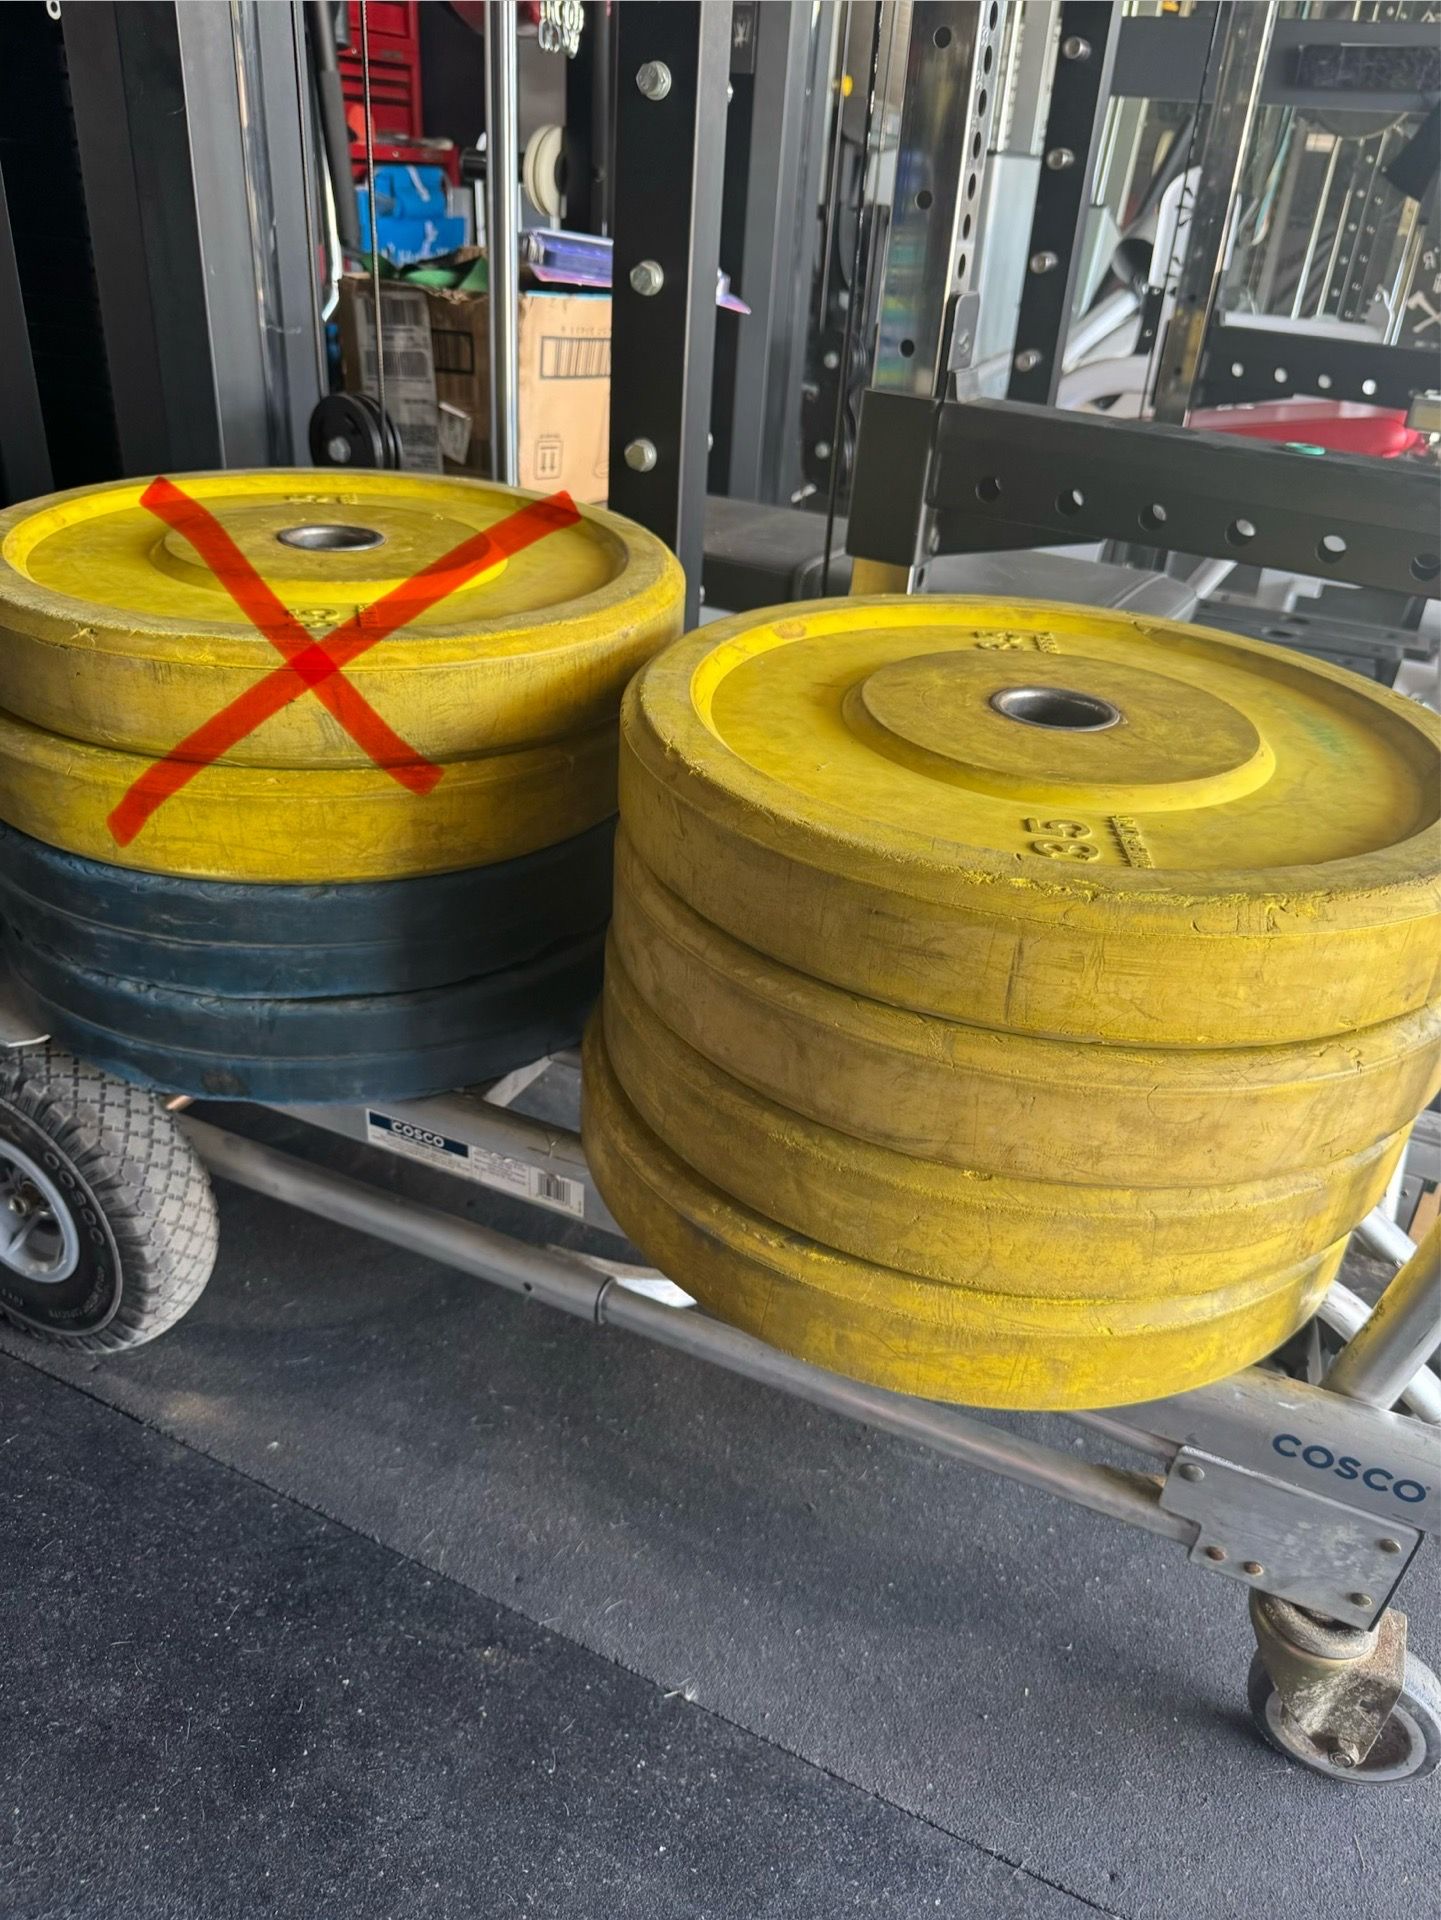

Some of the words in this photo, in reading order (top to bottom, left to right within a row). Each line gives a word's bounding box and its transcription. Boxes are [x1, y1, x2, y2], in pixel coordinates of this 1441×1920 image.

[1023, 816, 1099, 861] 35
[391, 1121, 445, 1148] COSCO
[1272, 1433, 1428, 1503] COSCO
